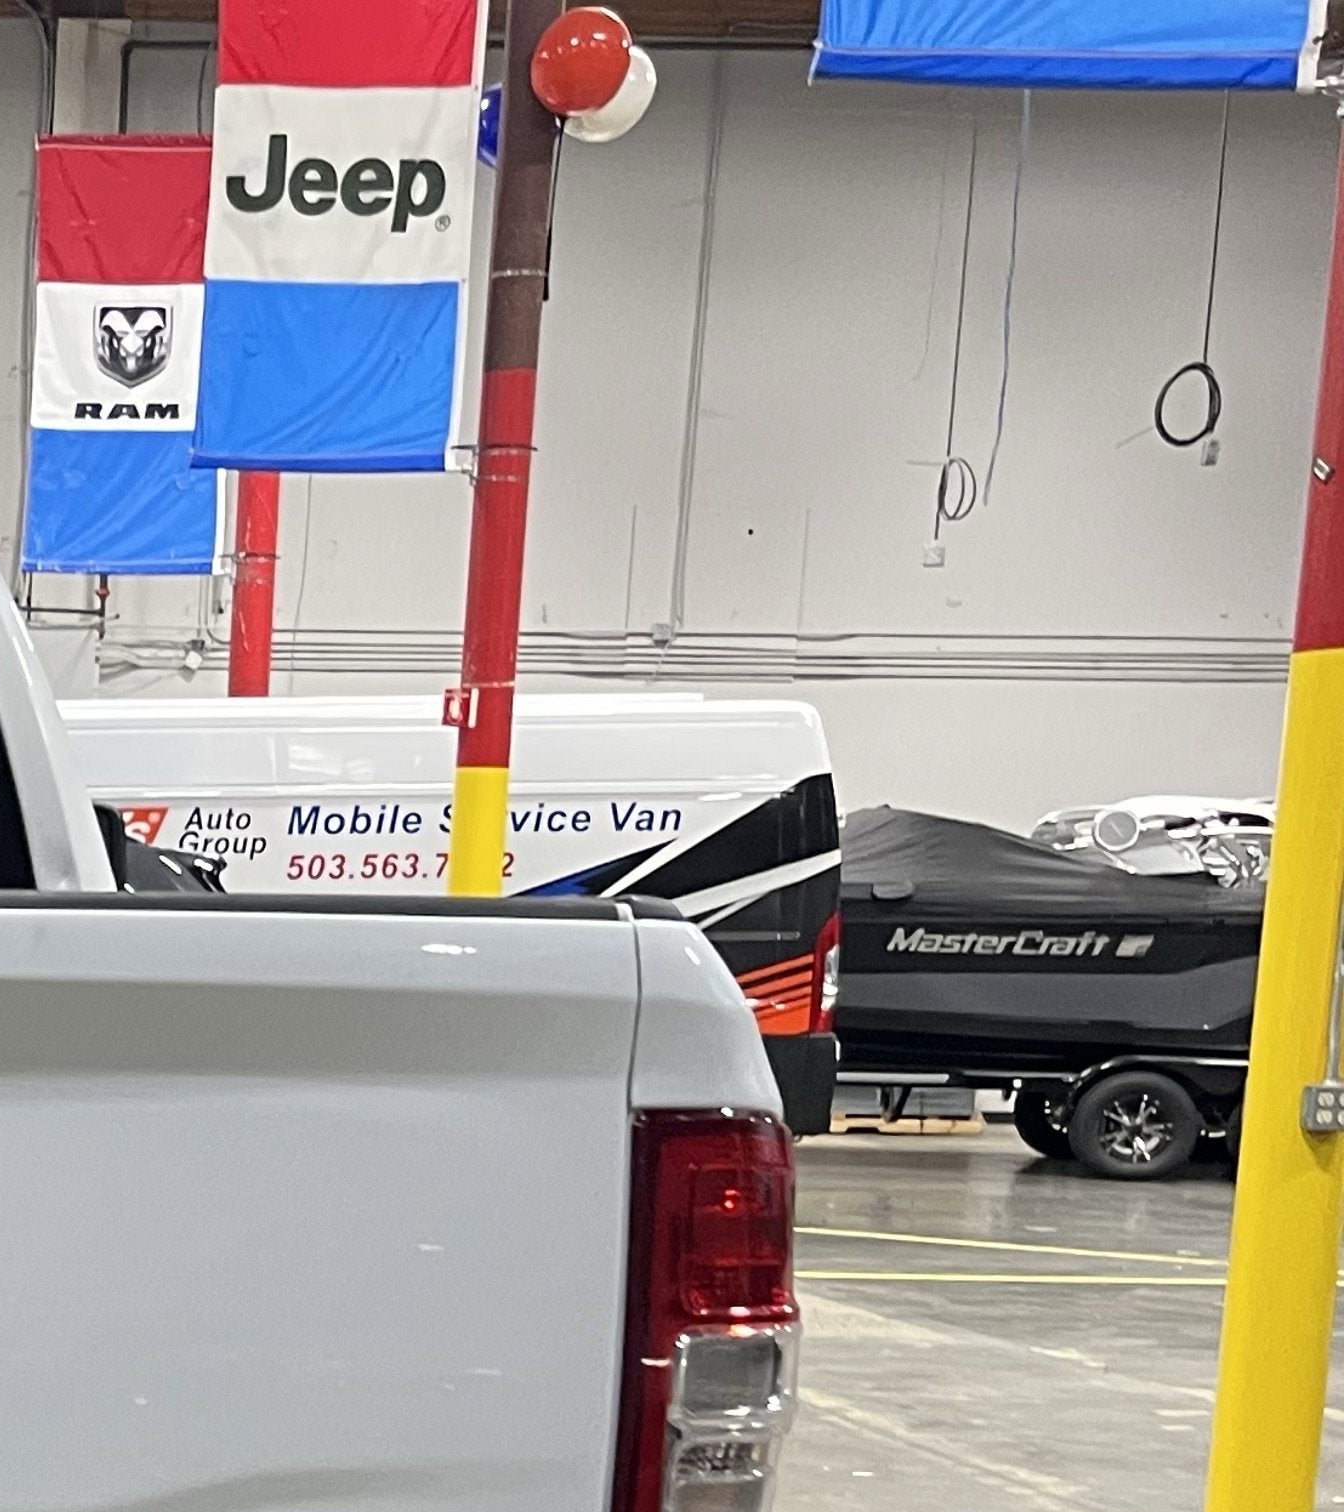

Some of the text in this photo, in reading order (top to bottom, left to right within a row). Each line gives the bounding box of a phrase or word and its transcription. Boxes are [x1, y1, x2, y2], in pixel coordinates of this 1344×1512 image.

[225, 133, 447, 233] Jeep
[73, 402, 180, 420] RAM
[184, 806, 251, 830] Auto
[287, 803, 422, 835] Mobile
[610, 801, 682, 832] Van
[178, 831, 267, 860] Group
[287, 852, 515, 880] 503.563.72
[886, 927, 1110, 957] MasterCraft
